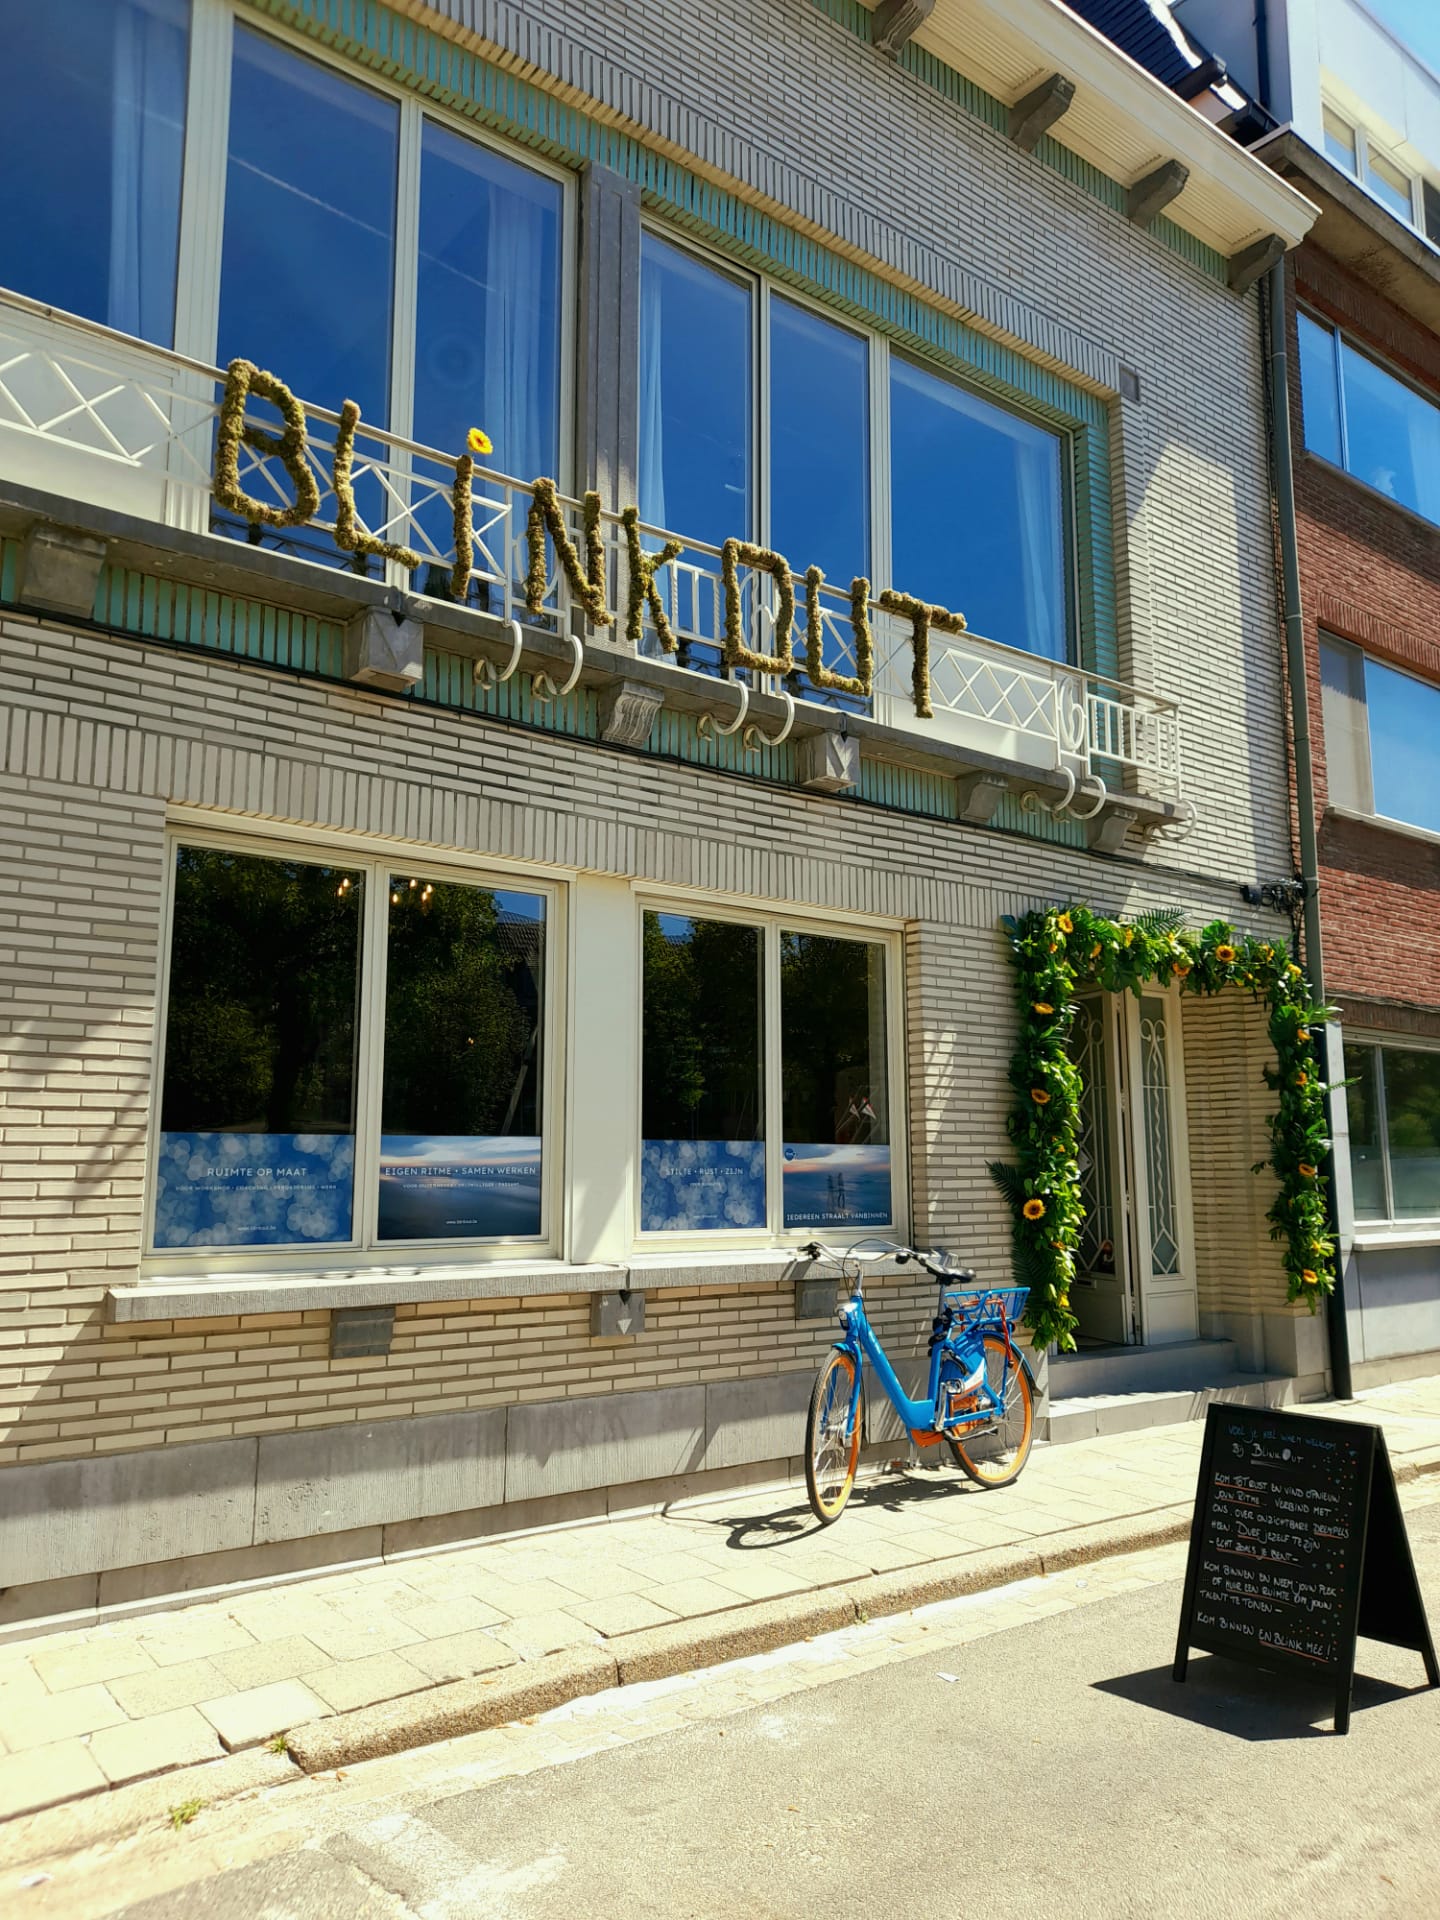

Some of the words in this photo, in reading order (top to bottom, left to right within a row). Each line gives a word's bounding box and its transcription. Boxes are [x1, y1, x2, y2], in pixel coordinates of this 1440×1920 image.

[207, 1167, 252, 1177] RUIMTE
[256, 1167, 273, 1177] OP
[276, 1167, 307, 1177] MAAT
[385, 1167, 417, 1176] EIGEN
[421, 1167, 451, 1176] RITME
[462, 1166, 494, 1175] SAMEN
[497, 1166, 536, 1175] WERKEN
[666, 1167, 692, 1176] STILTE
[699, 1167, 718, 1175] RUST
[725, 1167, 744, 1175] ZIJN
[786, 1213, 820, 1221] IEDEREEN
[821, 1212, 849, 1220] STRAALT
[1215, 1472, 1230, 1484] KOM
[1232, 1475, 1250, 1487] TOT
[1234, 1508, 1254, 1520] OVER
[1313, 1506, 1332, 1517] MET
[1203, 1560, 1220, 1573] KOM
[1197, 1611, 1215, 1625] KOM
[1258, 1628, 1272, 1642] EN
